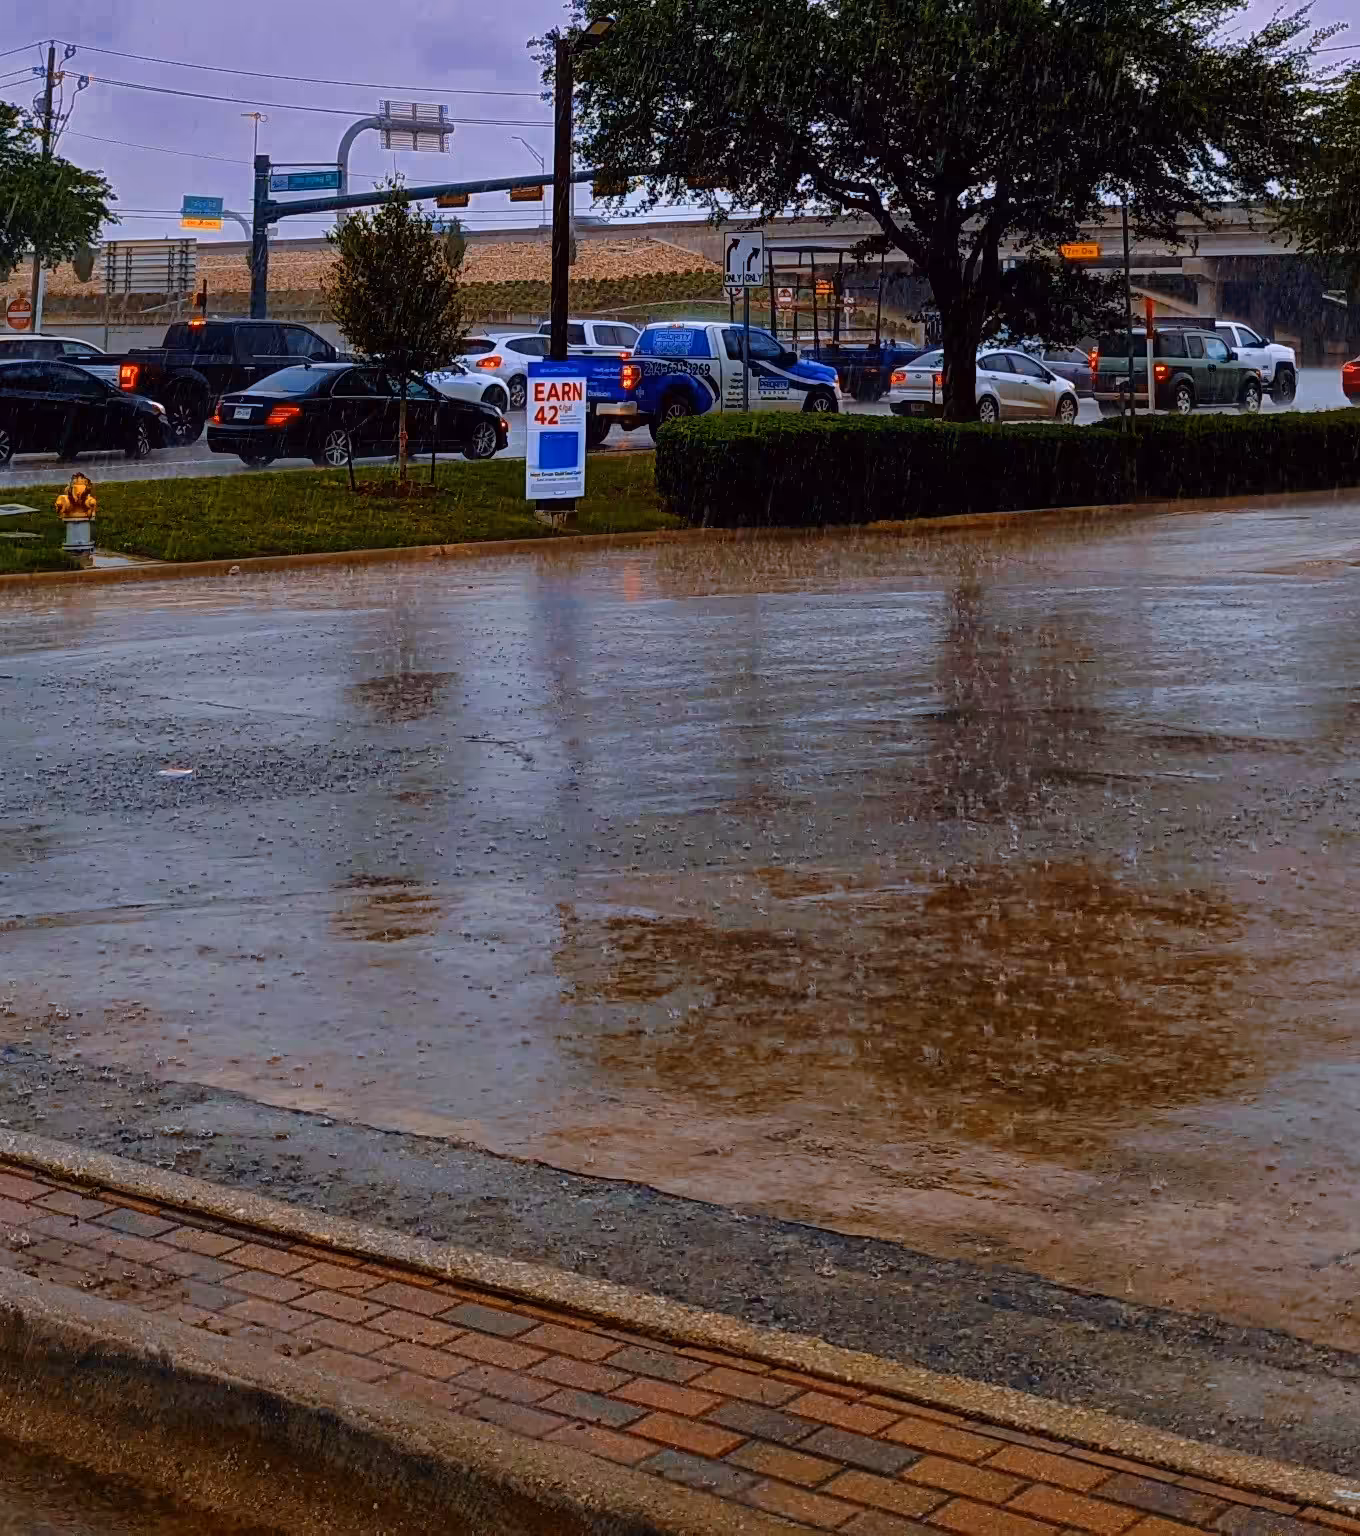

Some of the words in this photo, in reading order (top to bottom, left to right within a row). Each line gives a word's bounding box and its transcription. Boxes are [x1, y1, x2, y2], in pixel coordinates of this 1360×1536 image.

[724, 274, 742, 283] ONLY
[744, 273, 762, 282] ONLY
[534, 382, 583, 402] EARN
[534, 405, 559, 425] 42
